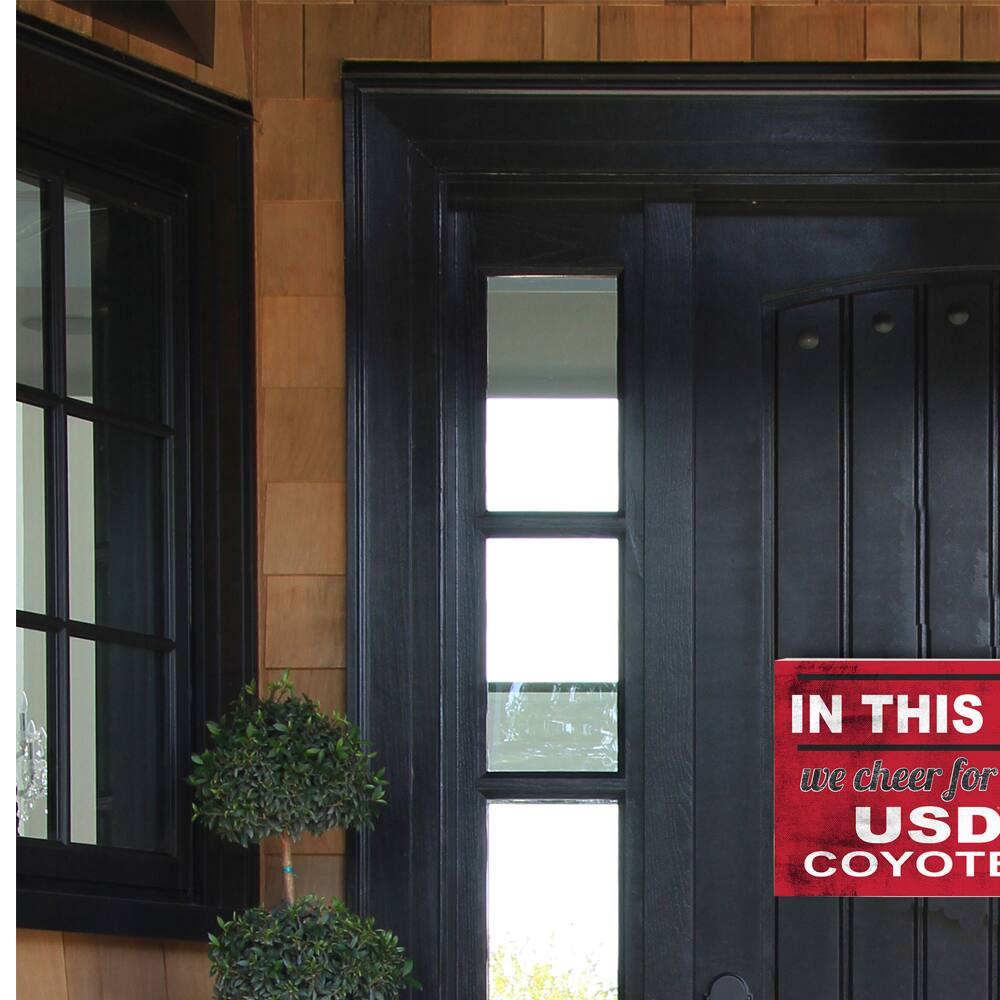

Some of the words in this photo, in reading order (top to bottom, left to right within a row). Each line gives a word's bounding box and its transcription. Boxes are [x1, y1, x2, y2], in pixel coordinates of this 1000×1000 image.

[791, 694, 842, 734] IN
[861, 694, 984, 735] THIS
[800, 767, 845, 792] we
[853, 759, 943, 792] cheer
[940, 757, 999, 802] for
